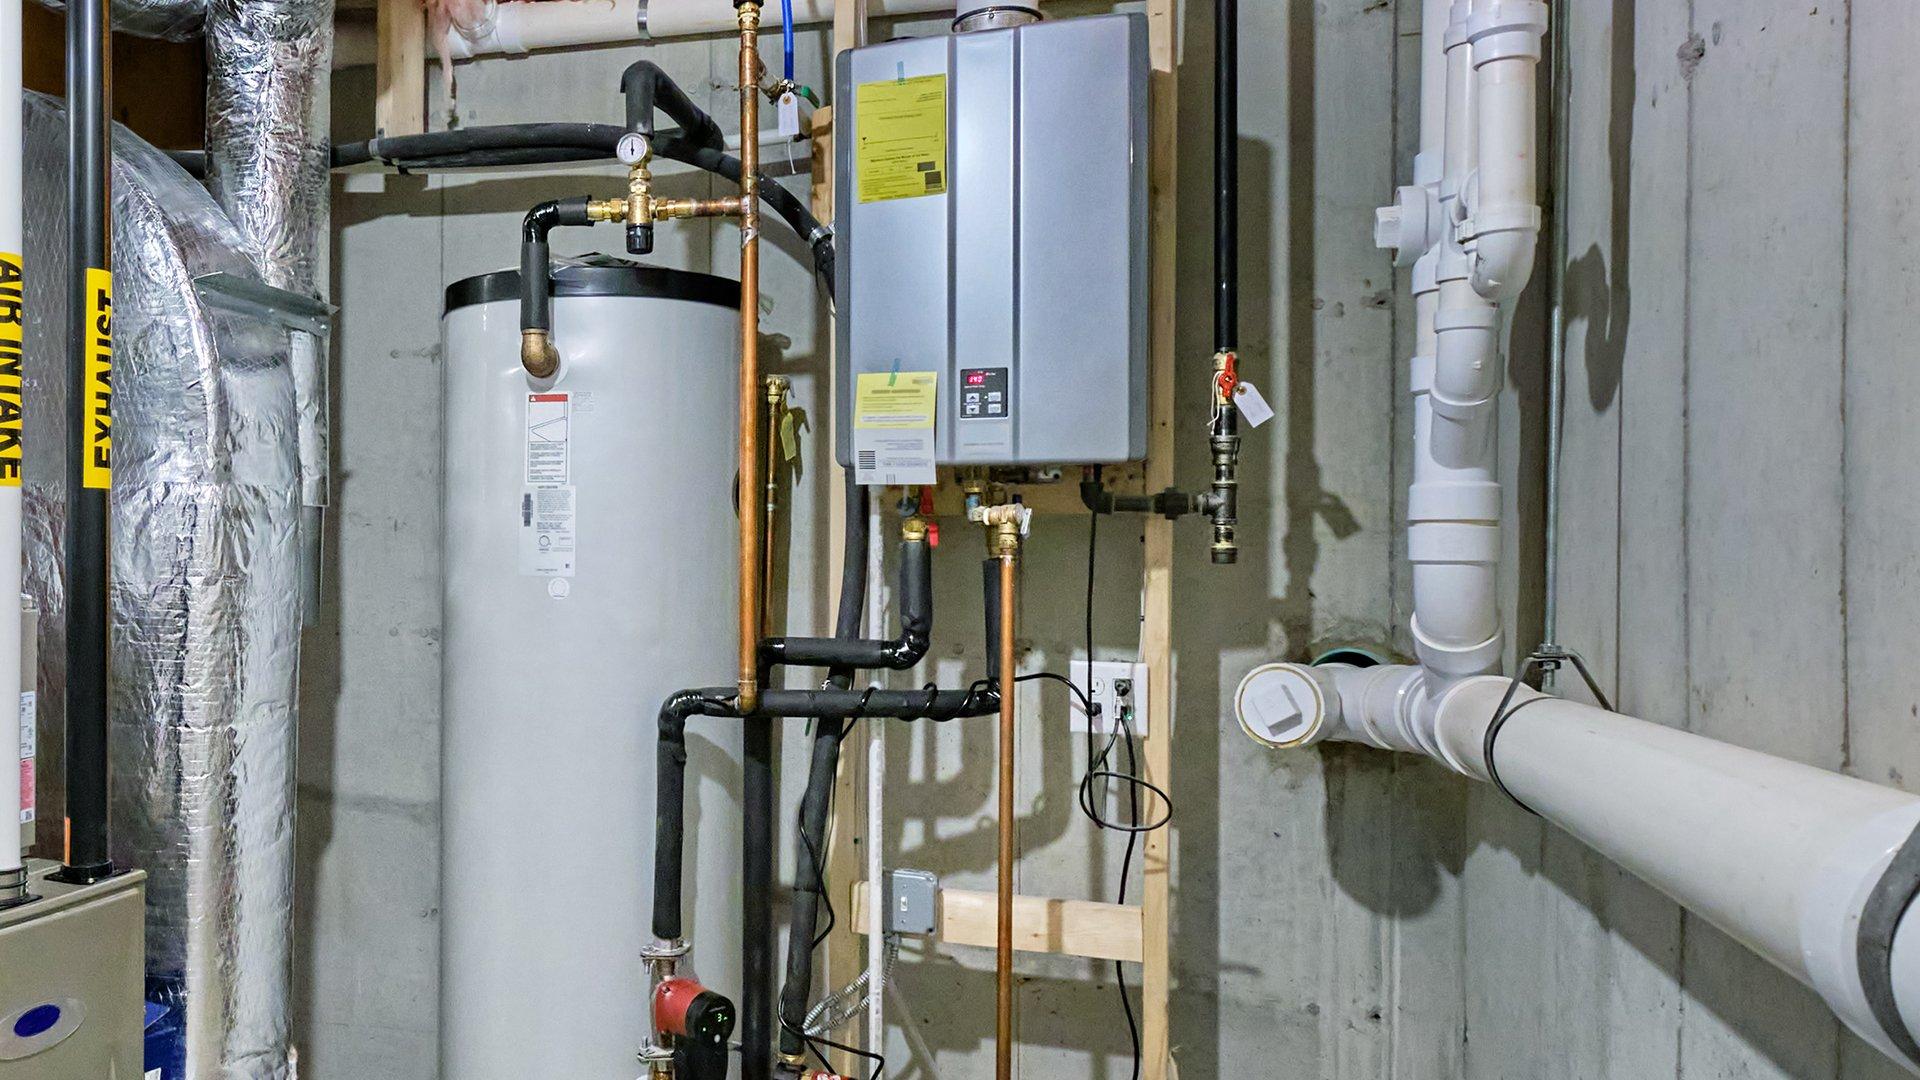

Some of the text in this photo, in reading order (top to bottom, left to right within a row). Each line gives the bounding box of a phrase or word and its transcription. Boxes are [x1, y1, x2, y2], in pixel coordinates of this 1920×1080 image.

[0, 259, 22, 480] AIR INTAKE
[94, 289, 111, 468] EXHAUST
